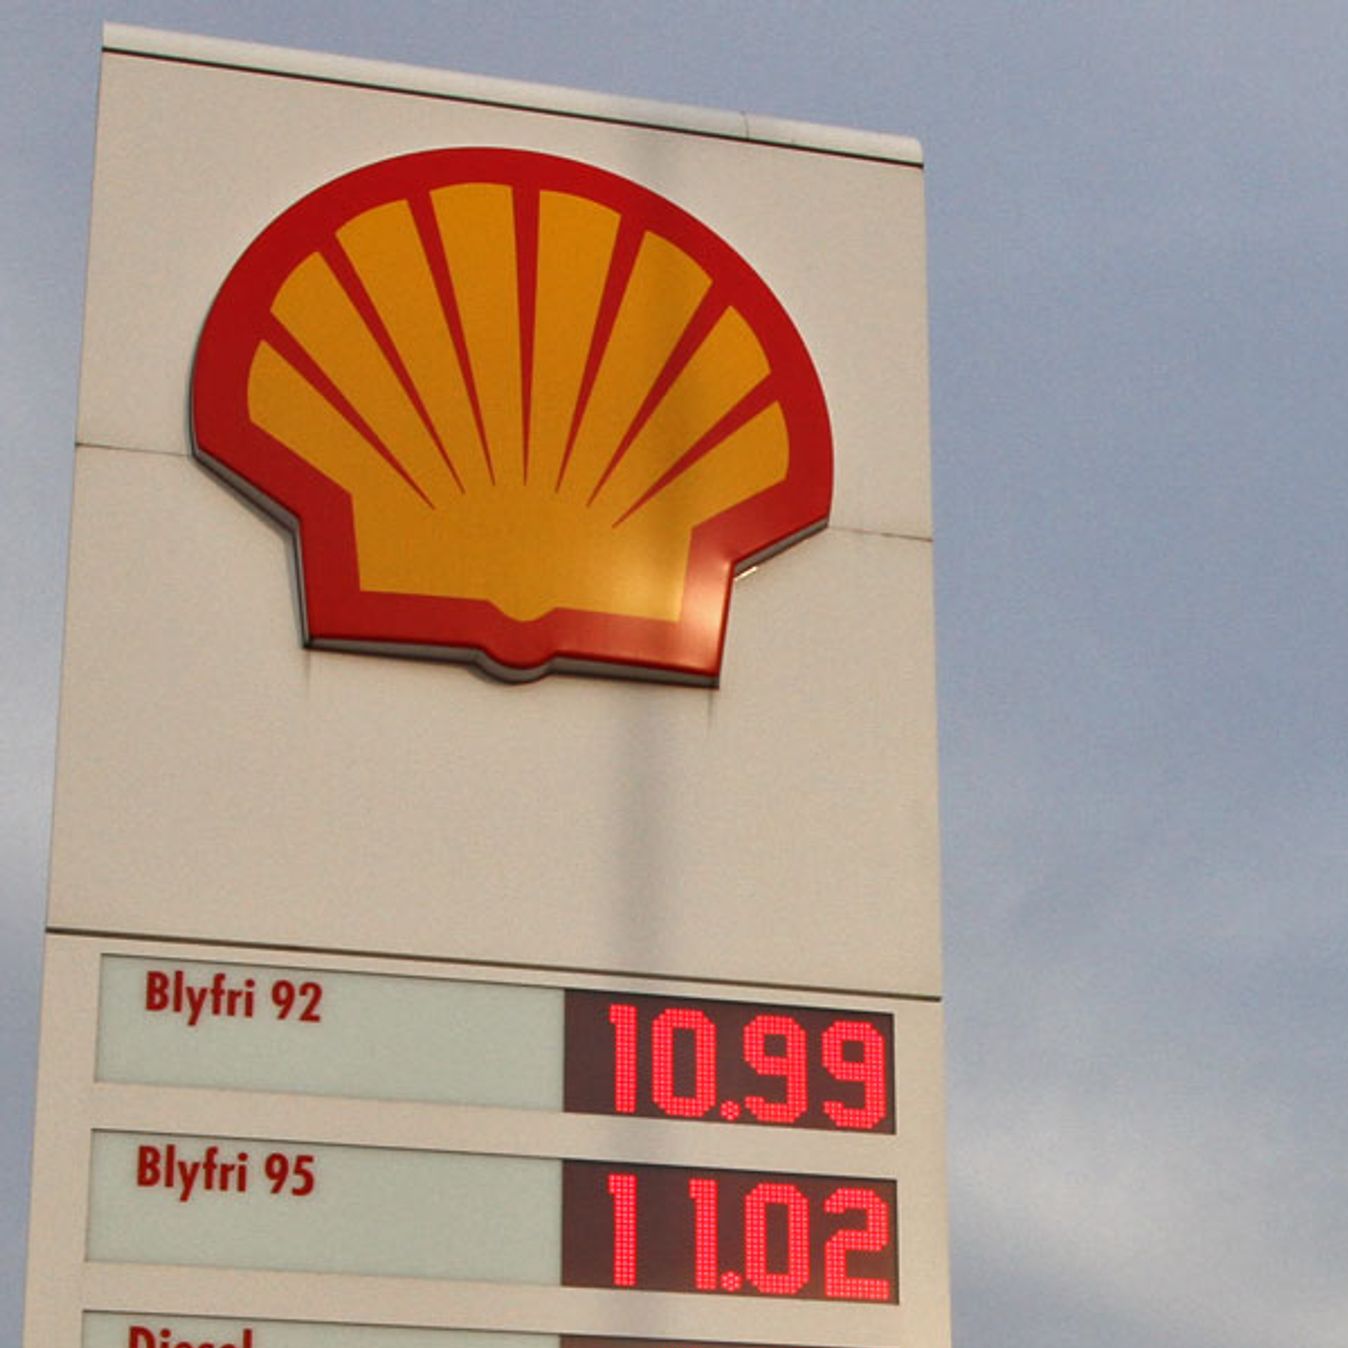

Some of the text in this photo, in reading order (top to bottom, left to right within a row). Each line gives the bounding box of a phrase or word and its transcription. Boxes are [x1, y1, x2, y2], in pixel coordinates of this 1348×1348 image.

[146, 970, 322, 1025] Blyfri 92
[609, 1004, 886, 1129] 10.99
[137, 1145, 315, 1202] Blyfri 95
[608, 1174, 890, 1301] 11.02
